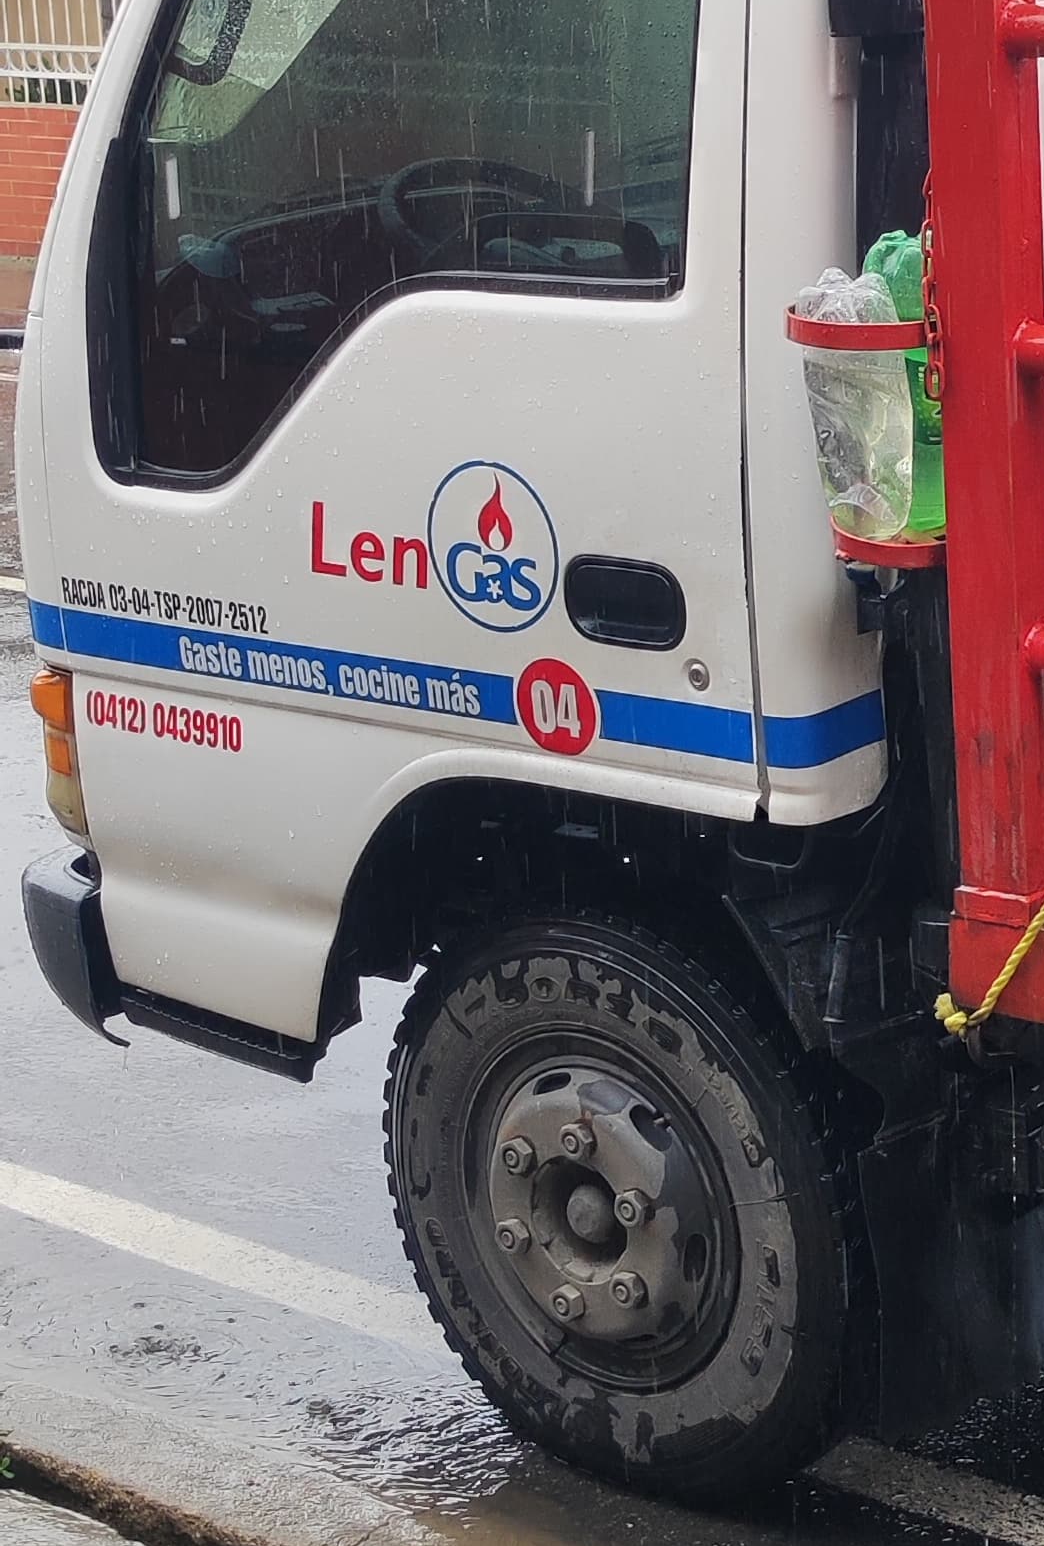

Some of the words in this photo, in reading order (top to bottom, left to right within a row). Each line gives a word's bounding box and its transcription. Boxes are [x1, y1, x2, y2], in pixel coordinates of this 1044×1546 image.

[311, 501, 428, 590] Len
[61, 576, 106, 610] RACDA
[109, 584, 269, 634] 03-04-TSP-2007-2512
[178, 635, 242, 678] Gaste
[247, 649, 334, 696] menos,
[338, 663, 420, 706] cocine
[426, 671, 481, 716] más
[86, 690, 146, 734] (0412)
[152, 702, 242, 753] 0439910
[530, 679, 581, 739] 04
